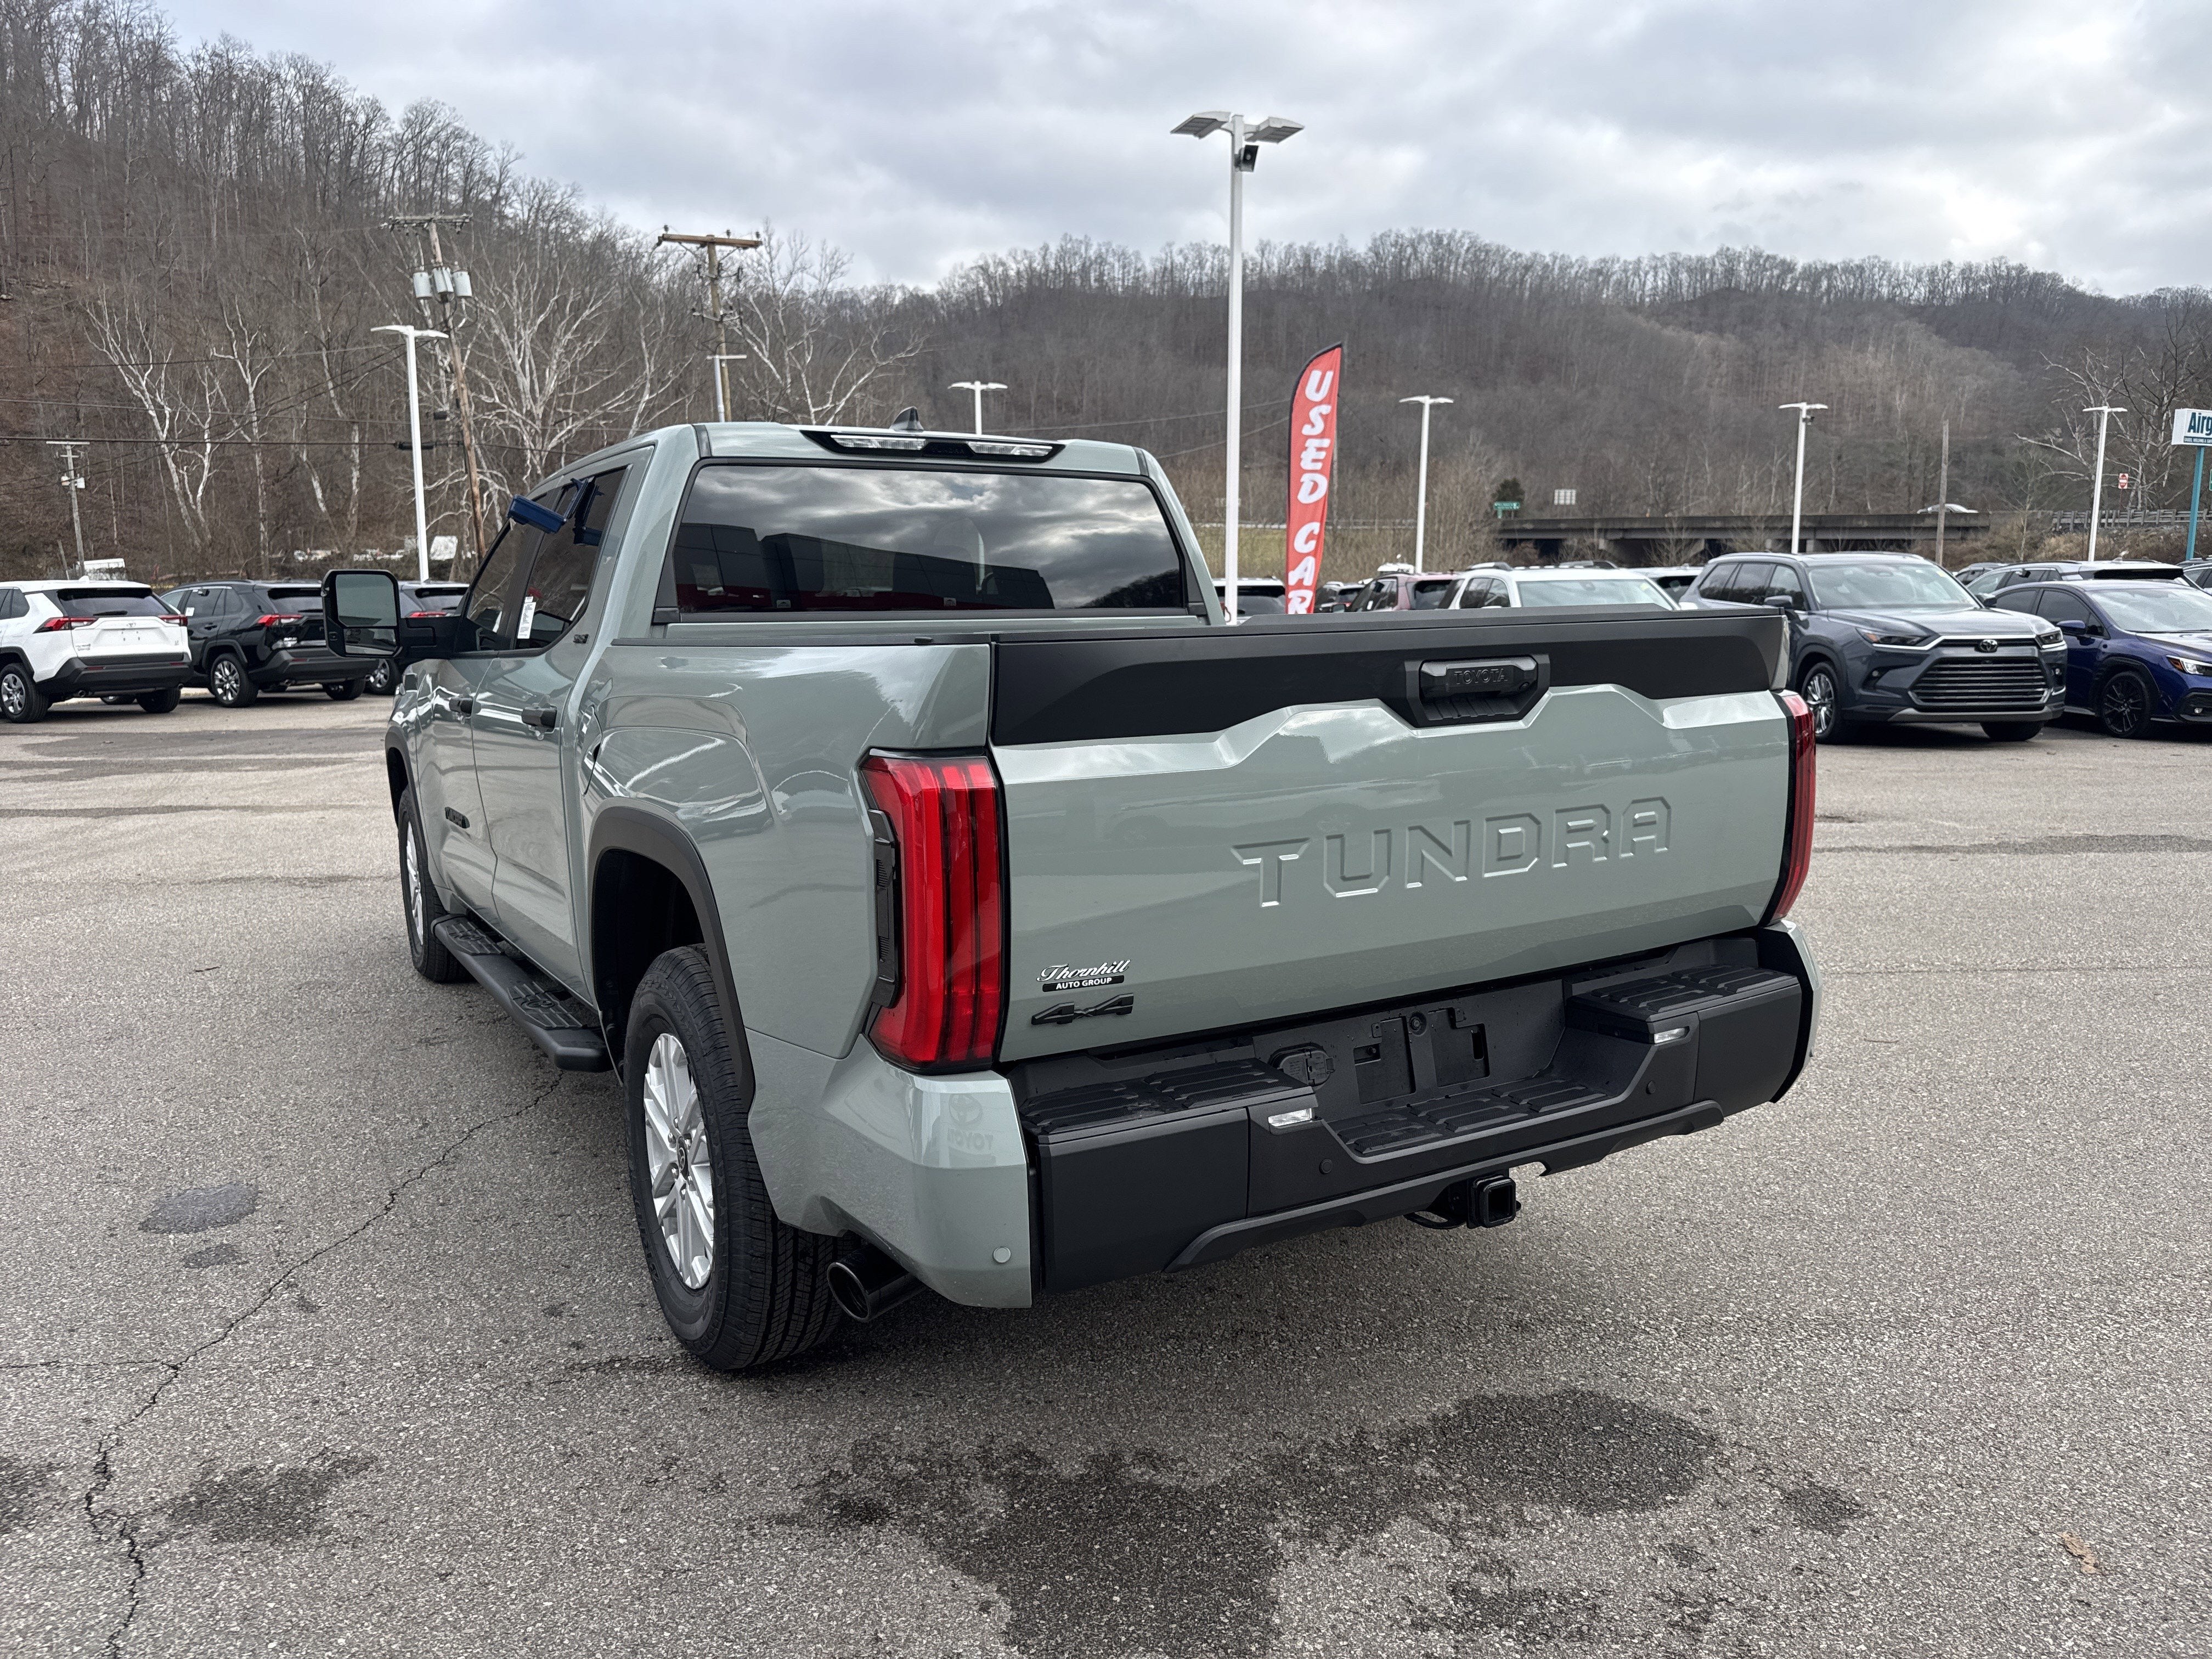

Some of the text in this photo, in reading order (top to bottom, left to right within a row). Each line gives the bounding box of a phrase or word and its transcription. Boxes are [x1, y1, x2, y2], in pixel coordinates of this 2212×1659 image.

[1297, 370, 1334, 504] USED
[1454, 668, 1508, 685] TOYOTA
[1231, 797, 1671, 908] TUNDRA
[1036, 960, 1131, 981] Thornhill
[1056, 977, 1113, 990] AUTO GROUP
